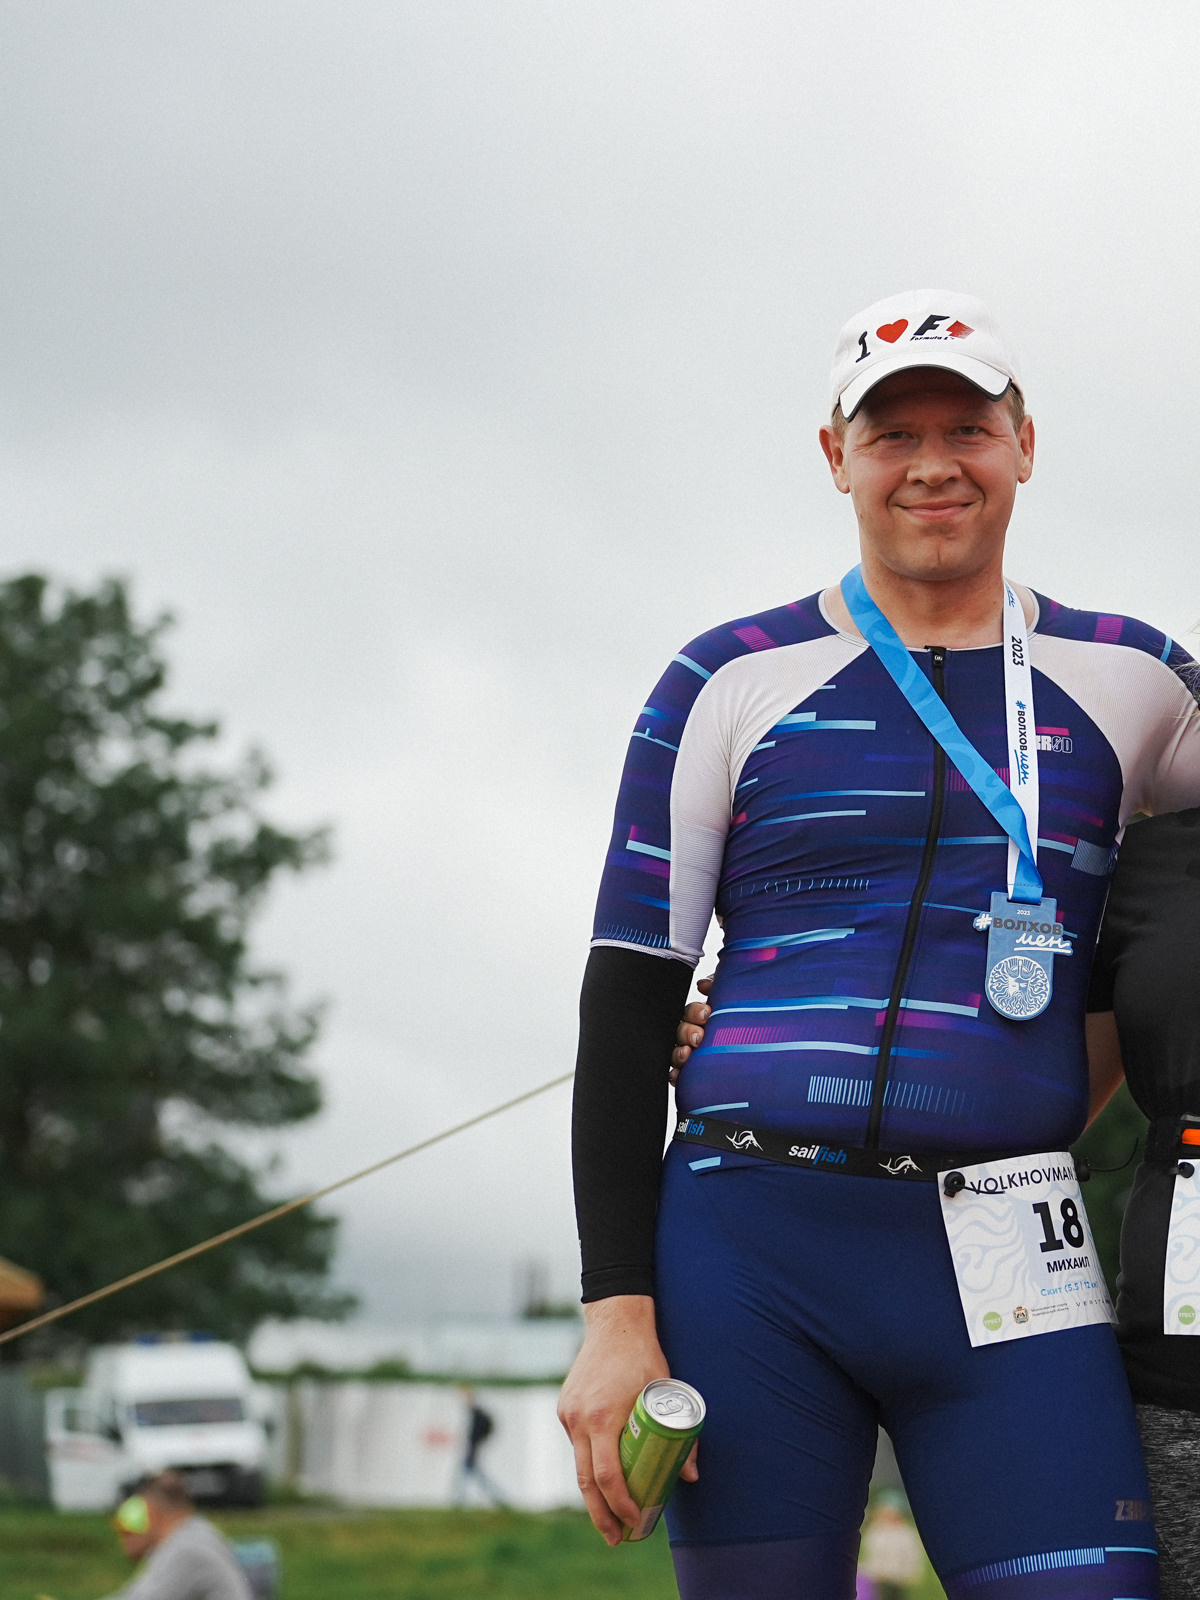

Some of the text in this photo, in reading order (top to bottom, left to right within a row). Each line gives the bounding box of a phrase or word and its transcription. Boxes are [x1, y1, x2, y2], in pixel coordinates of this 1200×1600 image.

[1011, 635, 1025, 667] 2023
[975, 912, 1064, 936] #ВОЛХОВ
[1014, 932, 1071, 949] мен
[678, 1118, 705, 1138] sailfish
[788, 1144, 848, 1165] sailfish
[1032, 1197, 1085, 1254] 18
[1046, 1255, 1091, 1274] МИХАИЛ
[1040, 1286, 1062, 1297] Скит
